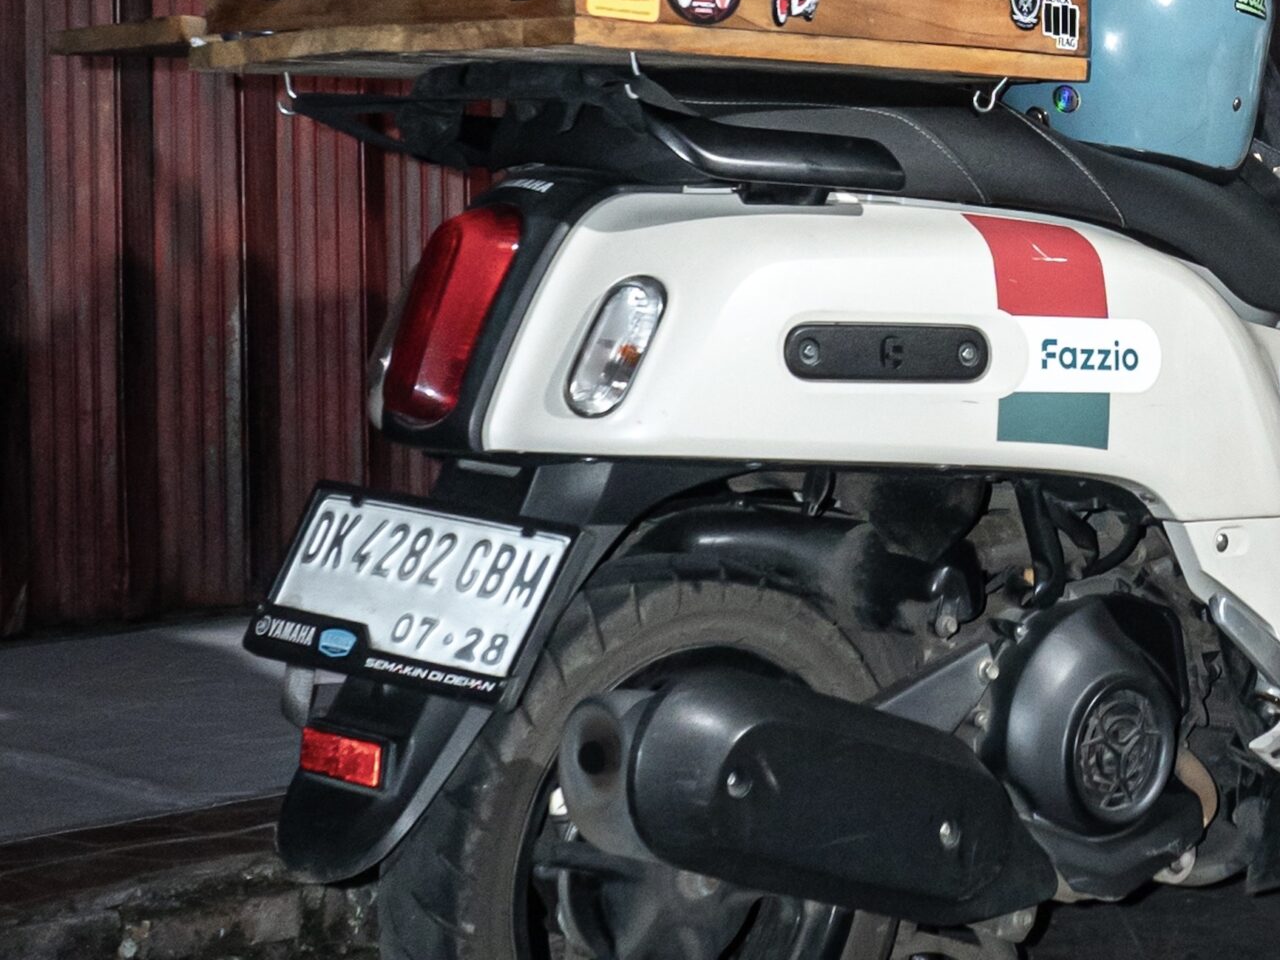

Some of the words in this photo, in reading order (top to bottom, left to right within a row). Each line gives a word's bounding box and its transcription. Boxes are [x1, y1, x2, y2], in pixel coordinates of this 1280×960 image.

[1058, 36, 1077, 48] FLAG
[1041, 338, 1139, 372] Fazzio
[300, 510, 362, 570] DK
[351, 519, 459, 587] 4282
[454, 538, 551, 609] GBM
[267, 618, 317, 647] YAMAHA
[363, 657, 430, 680] SEMAKIN
[426, 670, 446, 682] DI
[443, 673, 497, 692] DEPAN
